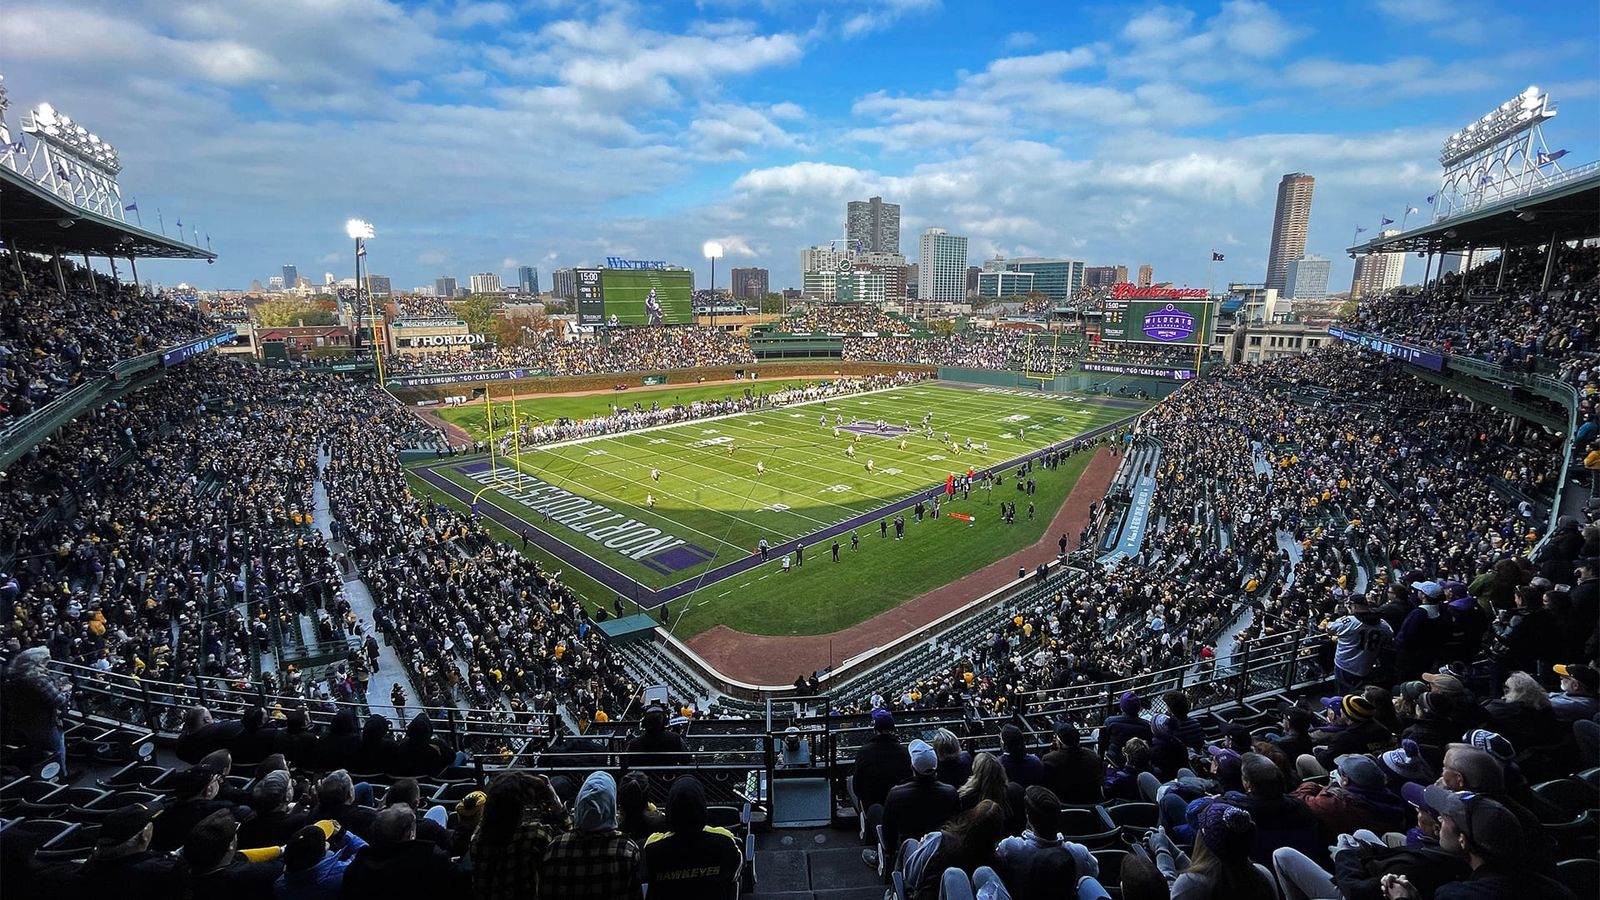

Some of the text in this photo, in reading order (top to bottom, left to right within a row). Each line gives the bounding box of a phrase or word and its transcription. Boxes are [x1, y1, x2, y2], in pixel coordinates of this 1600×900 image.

[581, 273, 598, 281] 15:00
[1145, 317, 1192, 326] WILDCATS
[423, 334, 486, 346] HORIZON
[1101, 365, 1125, 374] SINGING,
[408, 378, 429, 386] WE'RE
[430, 376, 459, 384] SINGING,
[465, 467, 686, 561] NORTHWESTERN
